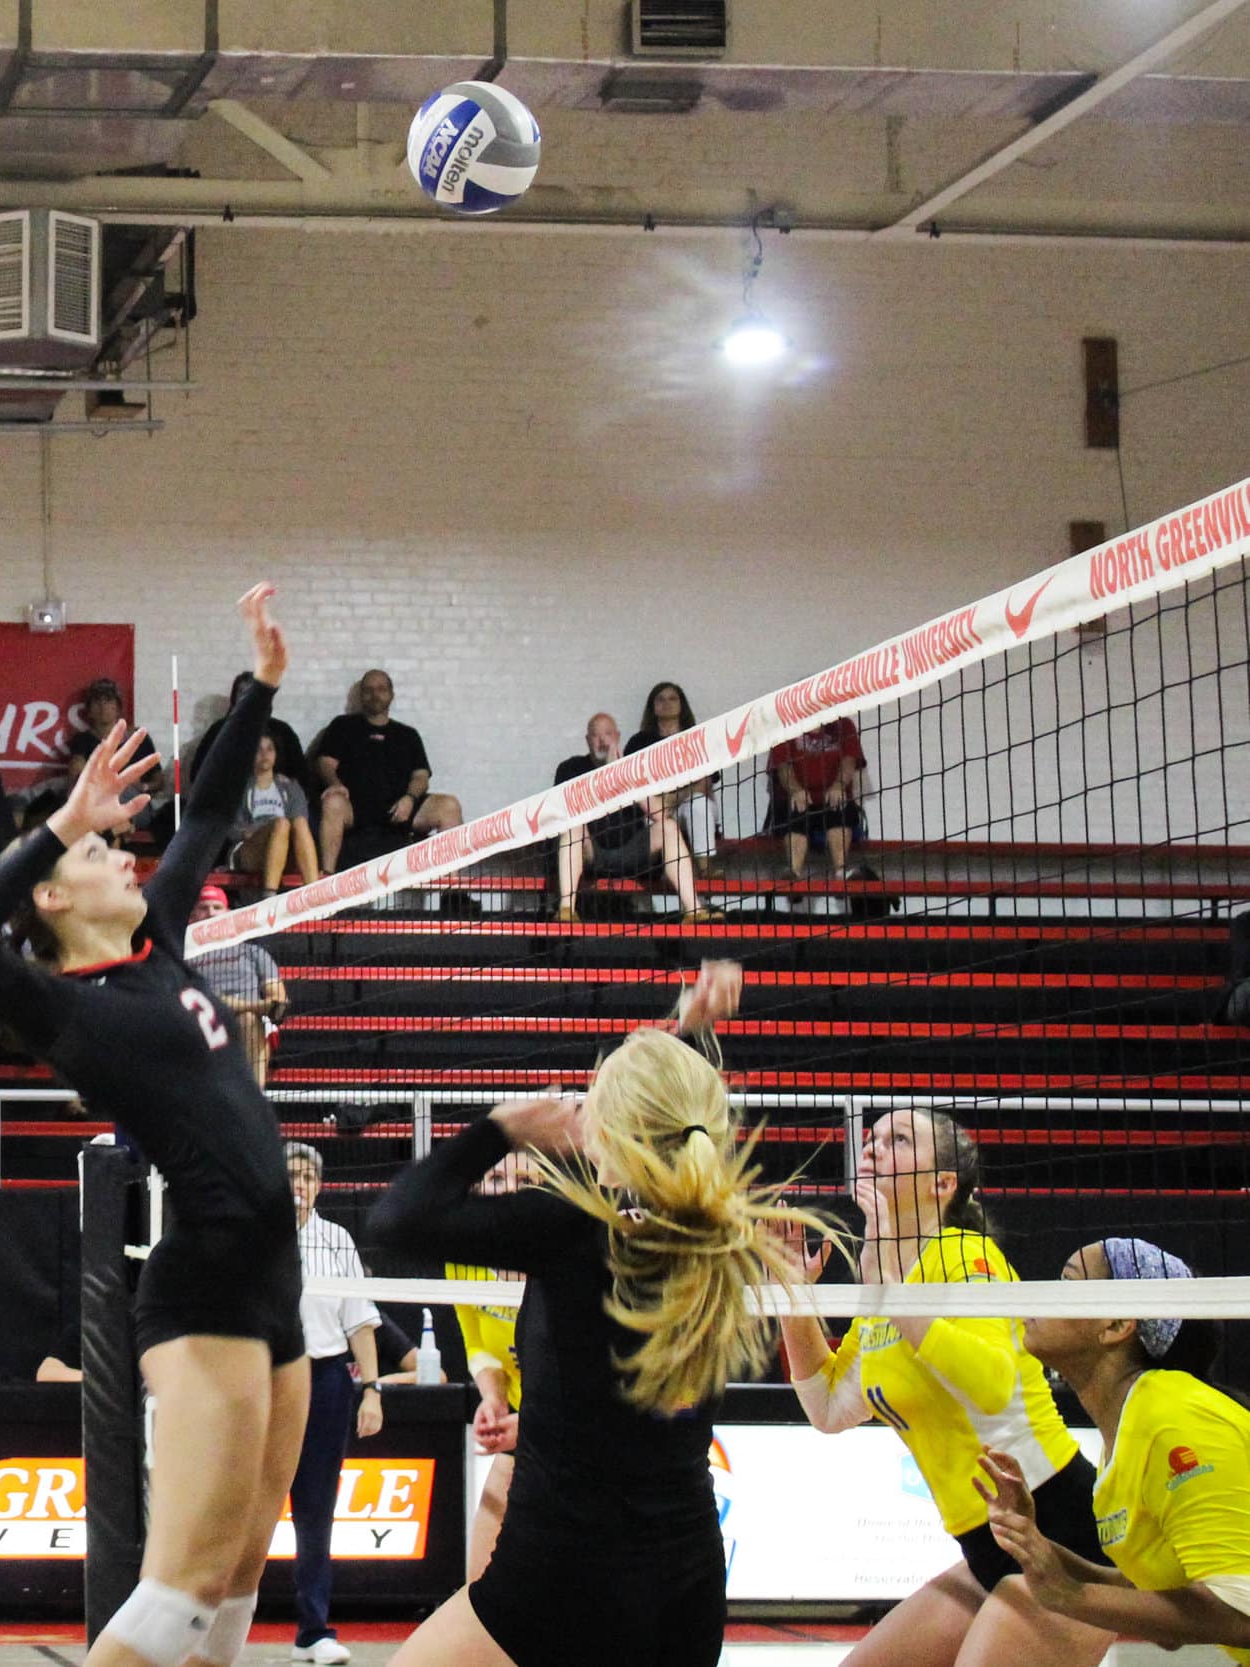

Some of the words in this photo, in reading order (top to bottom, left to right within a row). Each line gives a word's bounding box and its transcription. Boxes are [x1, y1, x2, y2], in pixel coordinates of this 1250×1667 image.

[422, 118, 460, 178] NCAA
[442, 127, 484, 192] molten
[1090, 529, 1155, 600] NORTH
[775, 679, 822, 728] NORTH
[815, 644, 900, 707] GREENVILLE
[901, 606, 983, 680] UNIVERSITY
[564, 775, 597, 818] NORTH
[593, 752, 649, 803] GREENVILLE
[650, 728, 710, 782] UNIVERSITY
[179, 987, 229, 1050] 2
